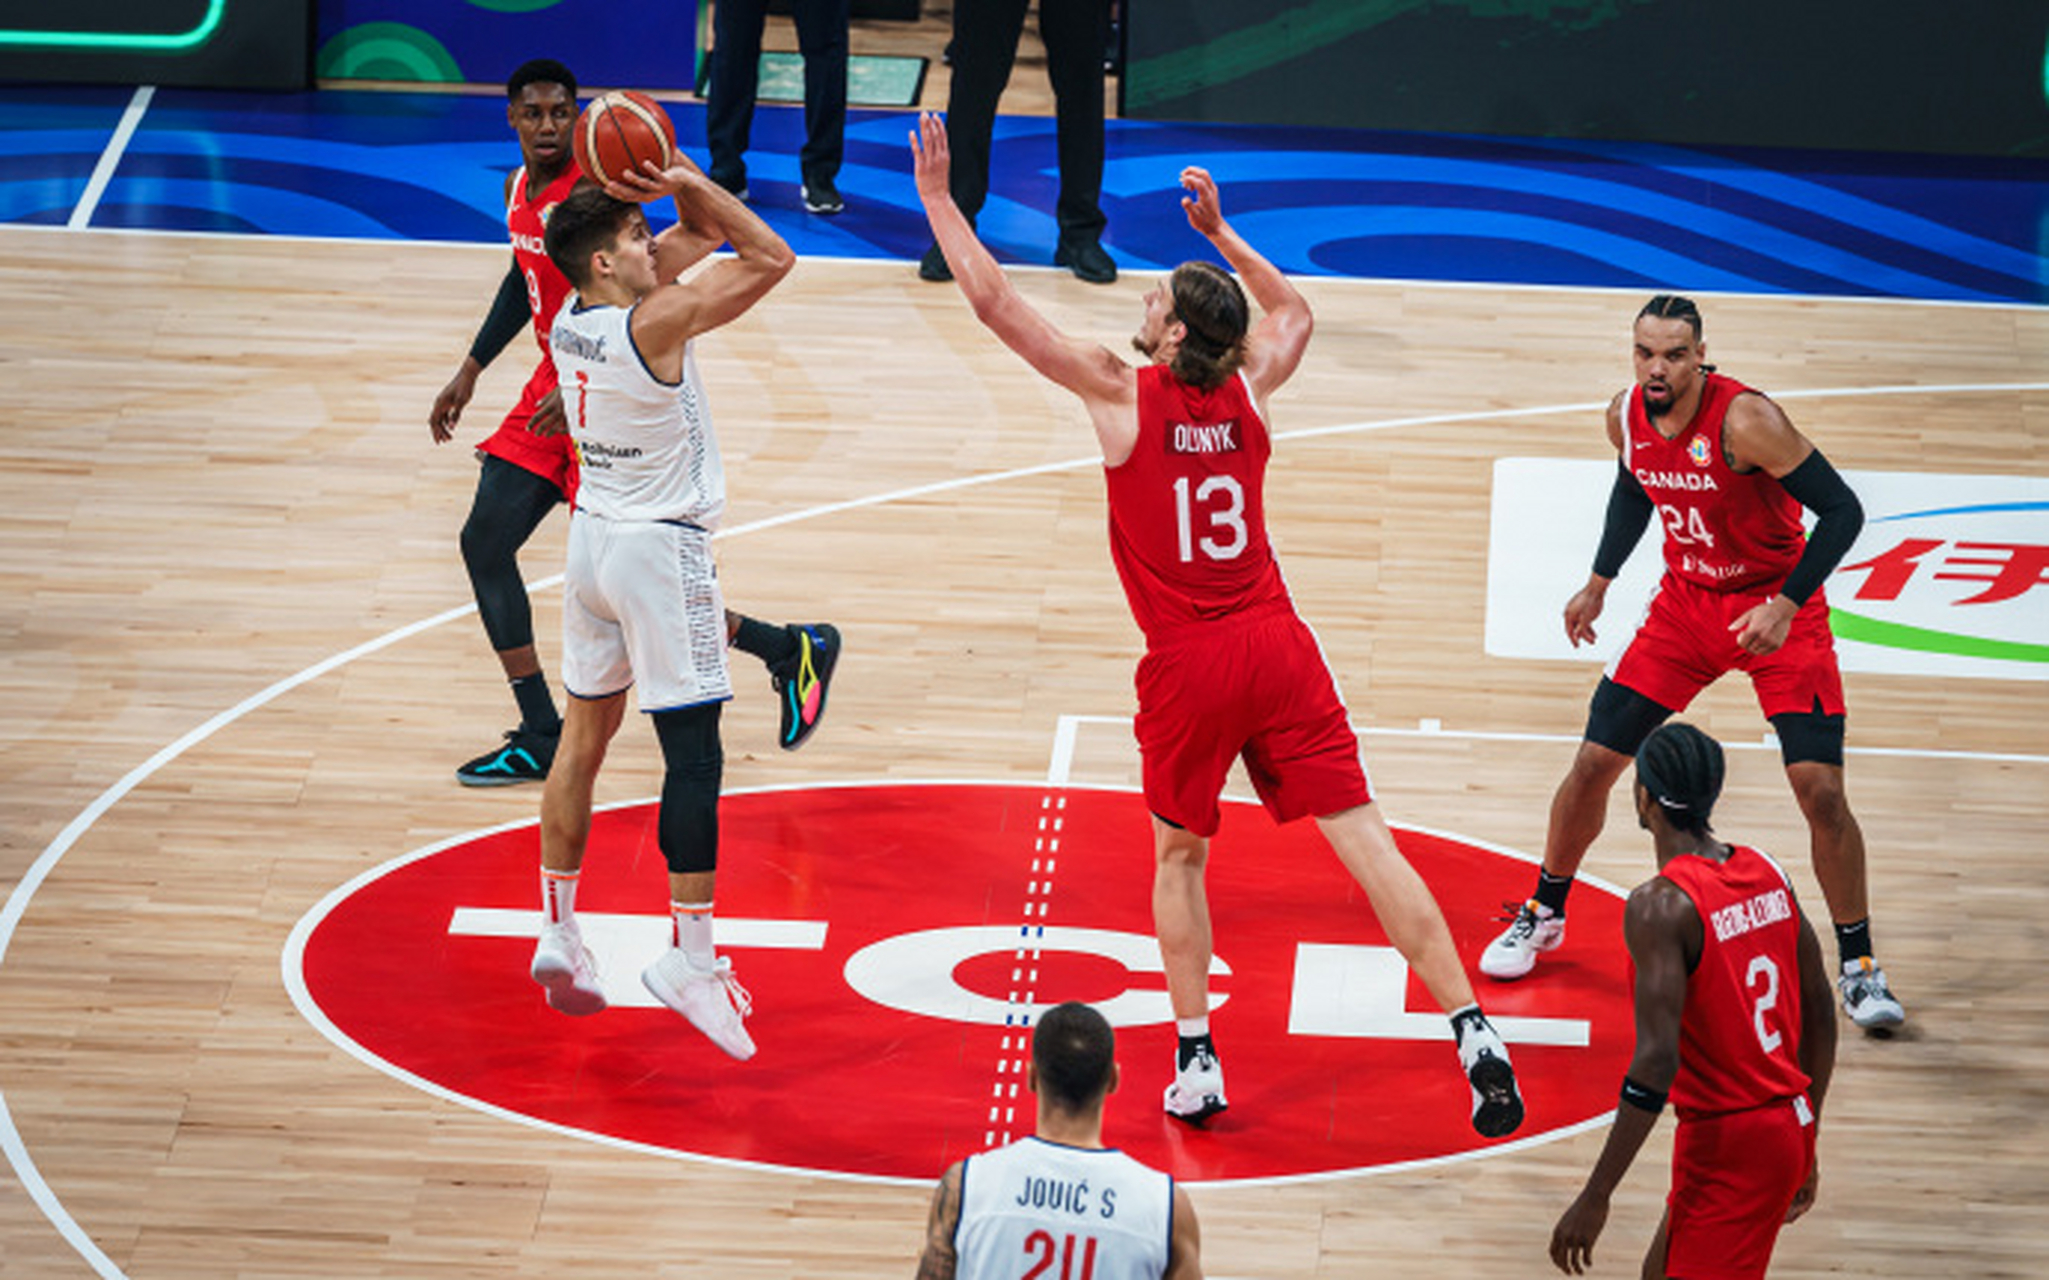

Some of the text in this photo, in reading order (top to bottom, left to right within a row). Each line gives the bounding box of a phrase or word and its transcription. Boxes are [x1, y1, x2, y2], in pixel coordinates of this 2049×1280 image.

[526, 268, 541, 315] 9
[1635, 468, 1719, 491] CANADA
[1173, 475, 1249, 562] 13
[1660, 503, 1715, 548] 24
[447, 906, 1591, 1047] TCL
[1745, 954, 1783, 1055] 2
[1016, 1176, 1117, 1220] JOVIĆ S
